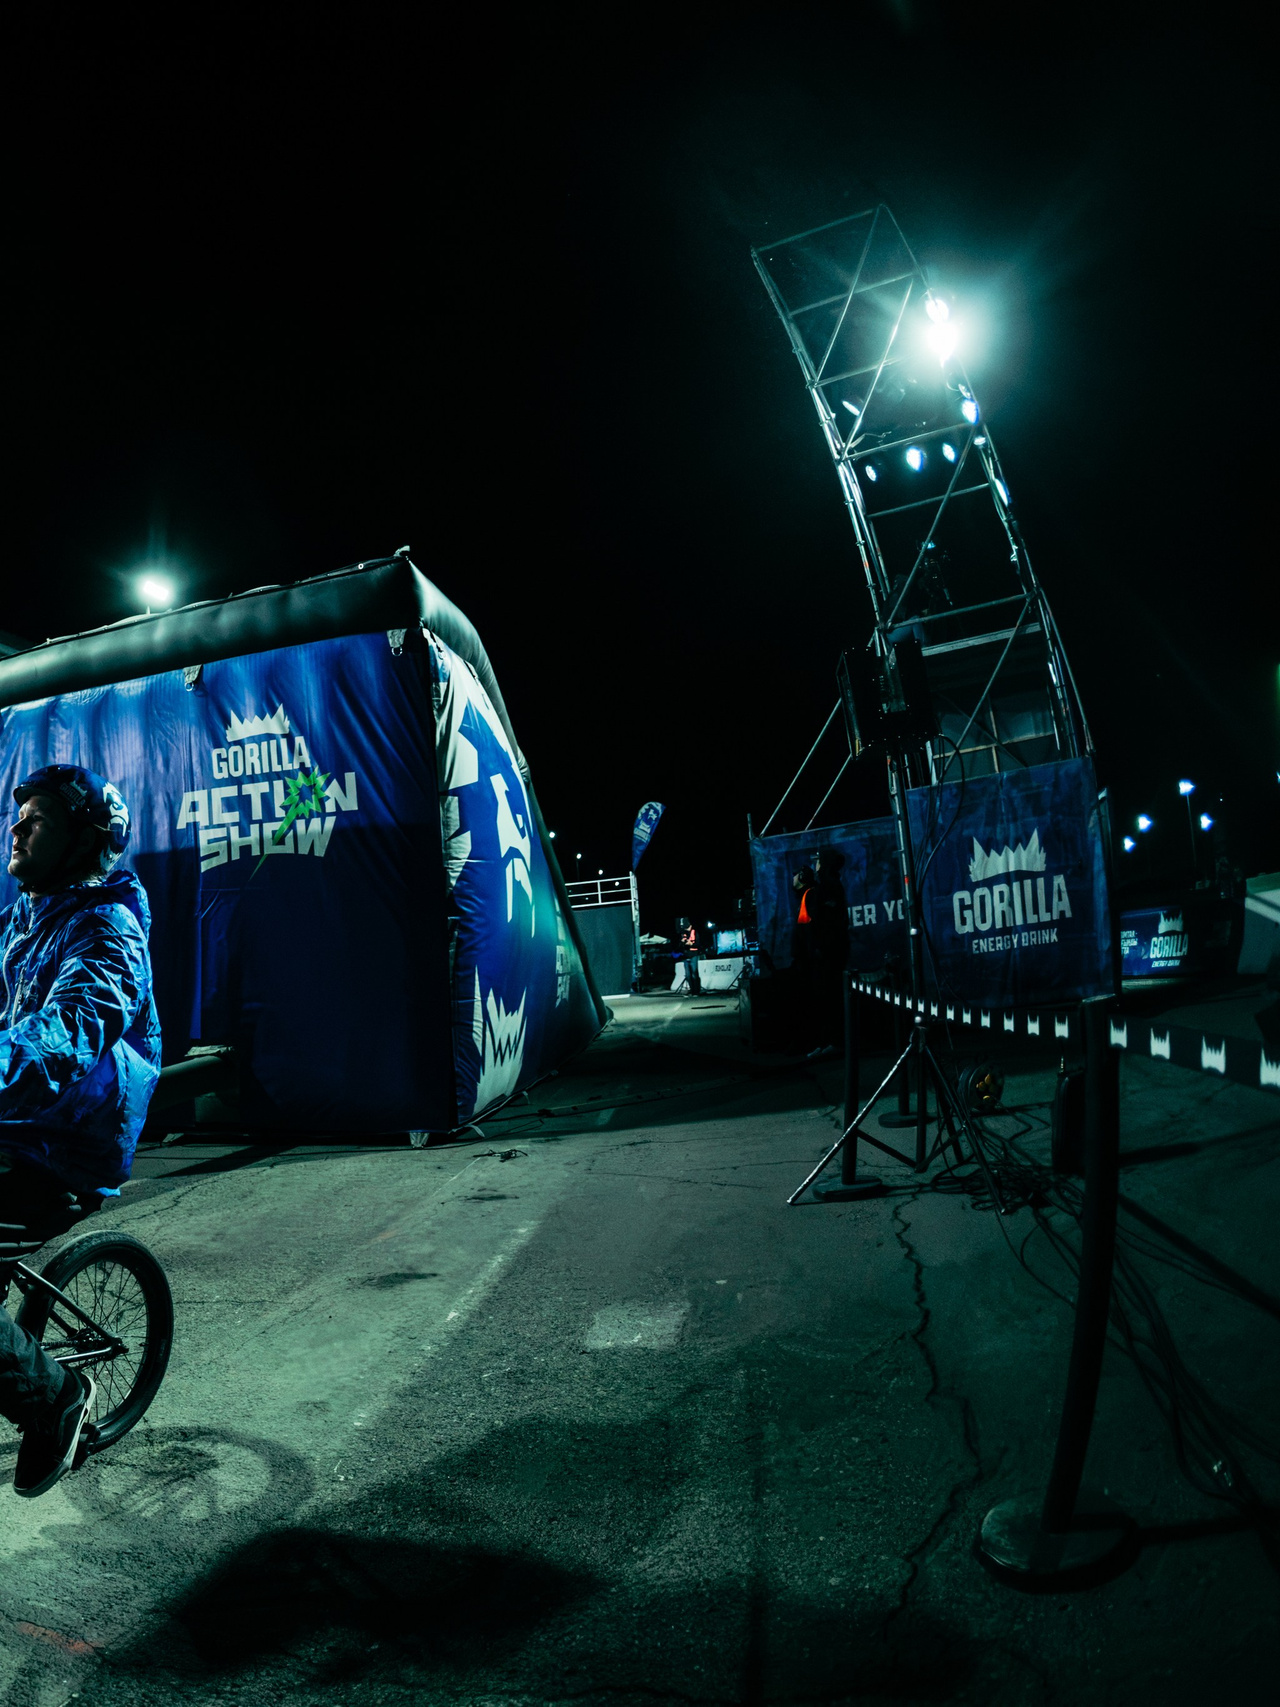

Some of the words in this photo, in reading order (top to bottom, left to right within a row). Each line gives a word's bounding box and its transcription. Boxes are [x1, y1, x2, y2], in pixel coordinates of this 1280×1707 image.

[211, 735, 312, 780] GORILLA
[199, 815, 337, 873] SHOW
[952, 874, 1073, 935] GORILLA
[971, 933, 1019, 955] ENERGY
[1021, 927, 1059, 947] DRINK
[1149, 933, 1189, 959] GORILLA
